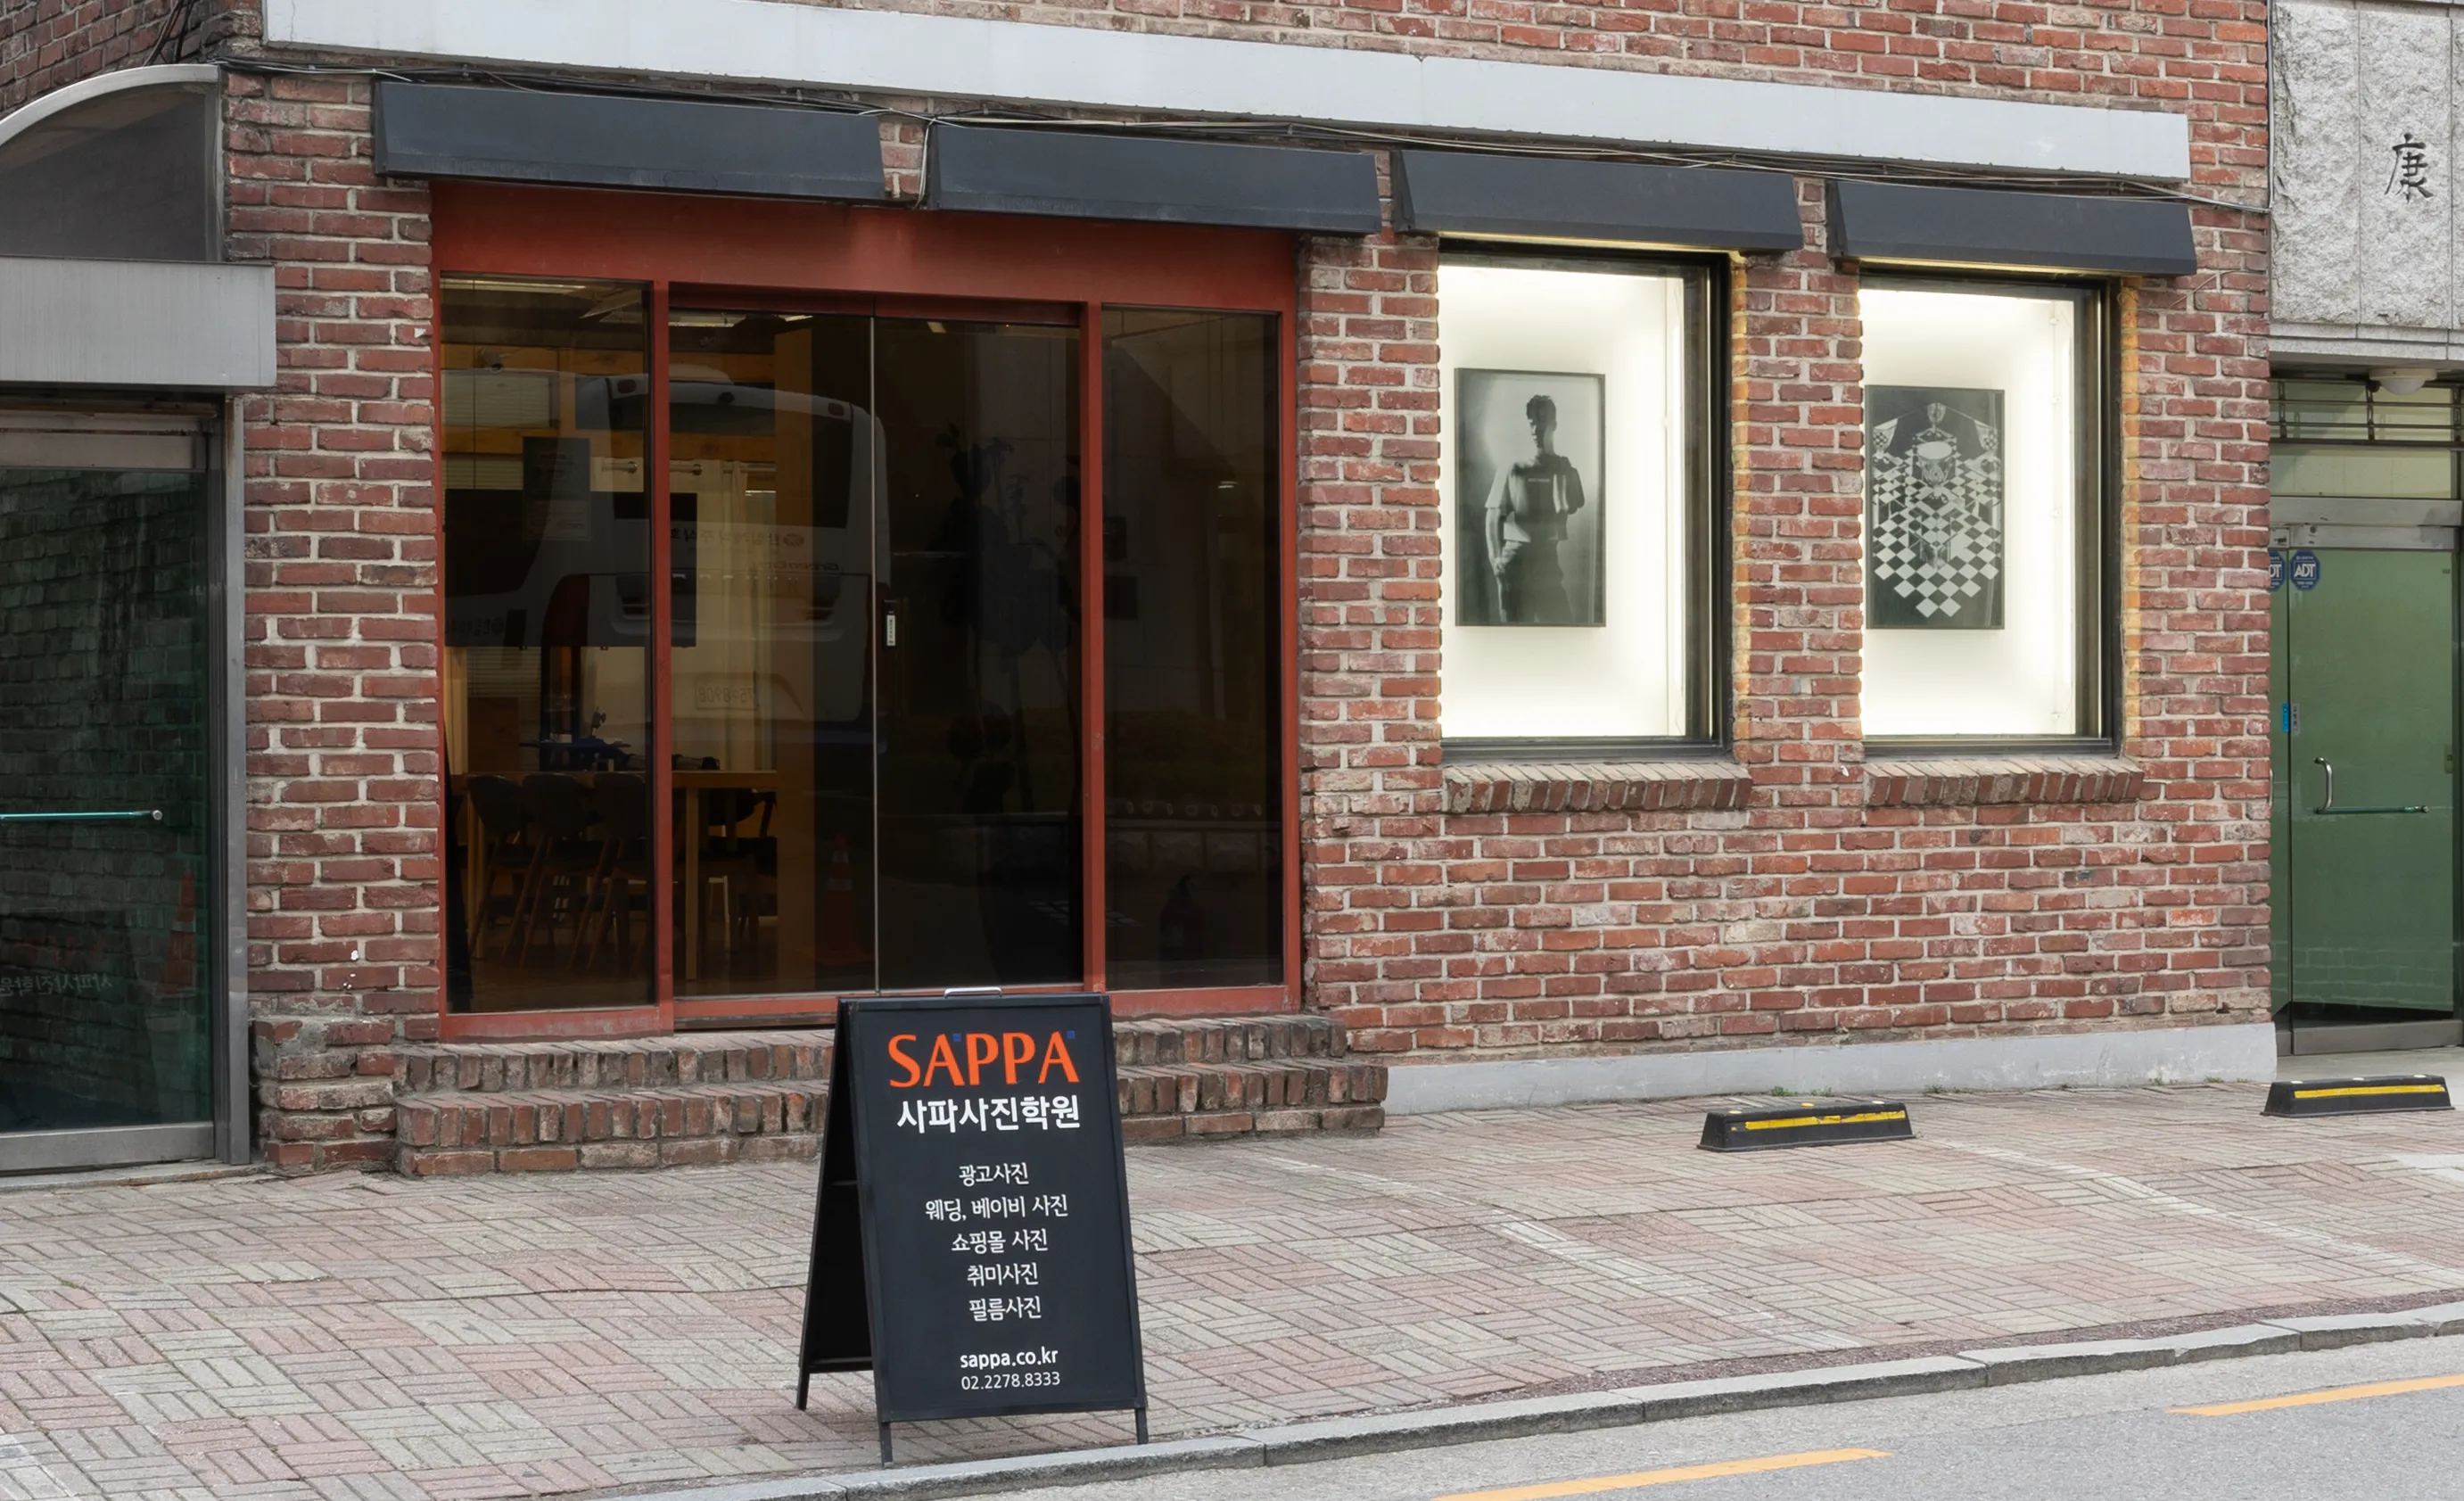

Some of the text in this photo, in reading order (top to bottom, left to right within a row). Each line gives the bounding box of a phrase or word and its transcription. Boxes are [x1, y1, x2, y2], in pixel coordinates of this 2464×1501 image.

[2269, 564, 2282, 578] DT
[2293, 563, 2316, 578] ADT
[887, 1031, 1080, 1088] SAPPA
[896, 1094, 1081, 1134] 사파사진학원
[958, 1161, 1030, 1188] 광고사진
[925, 1193, 1069, 1223] 웨딩, 베이비 사진
[951, 1227, 1049, 1255] 쇼핑몰 사진
[966, 1261, 1039, 1287] 취미사진
[968, 1295, 1042, 1323] 필름사진
[960, 1345, 1059, 1371] sappa.co.kr
[960, 1371, 1061, 1390] 02.2278.8333
